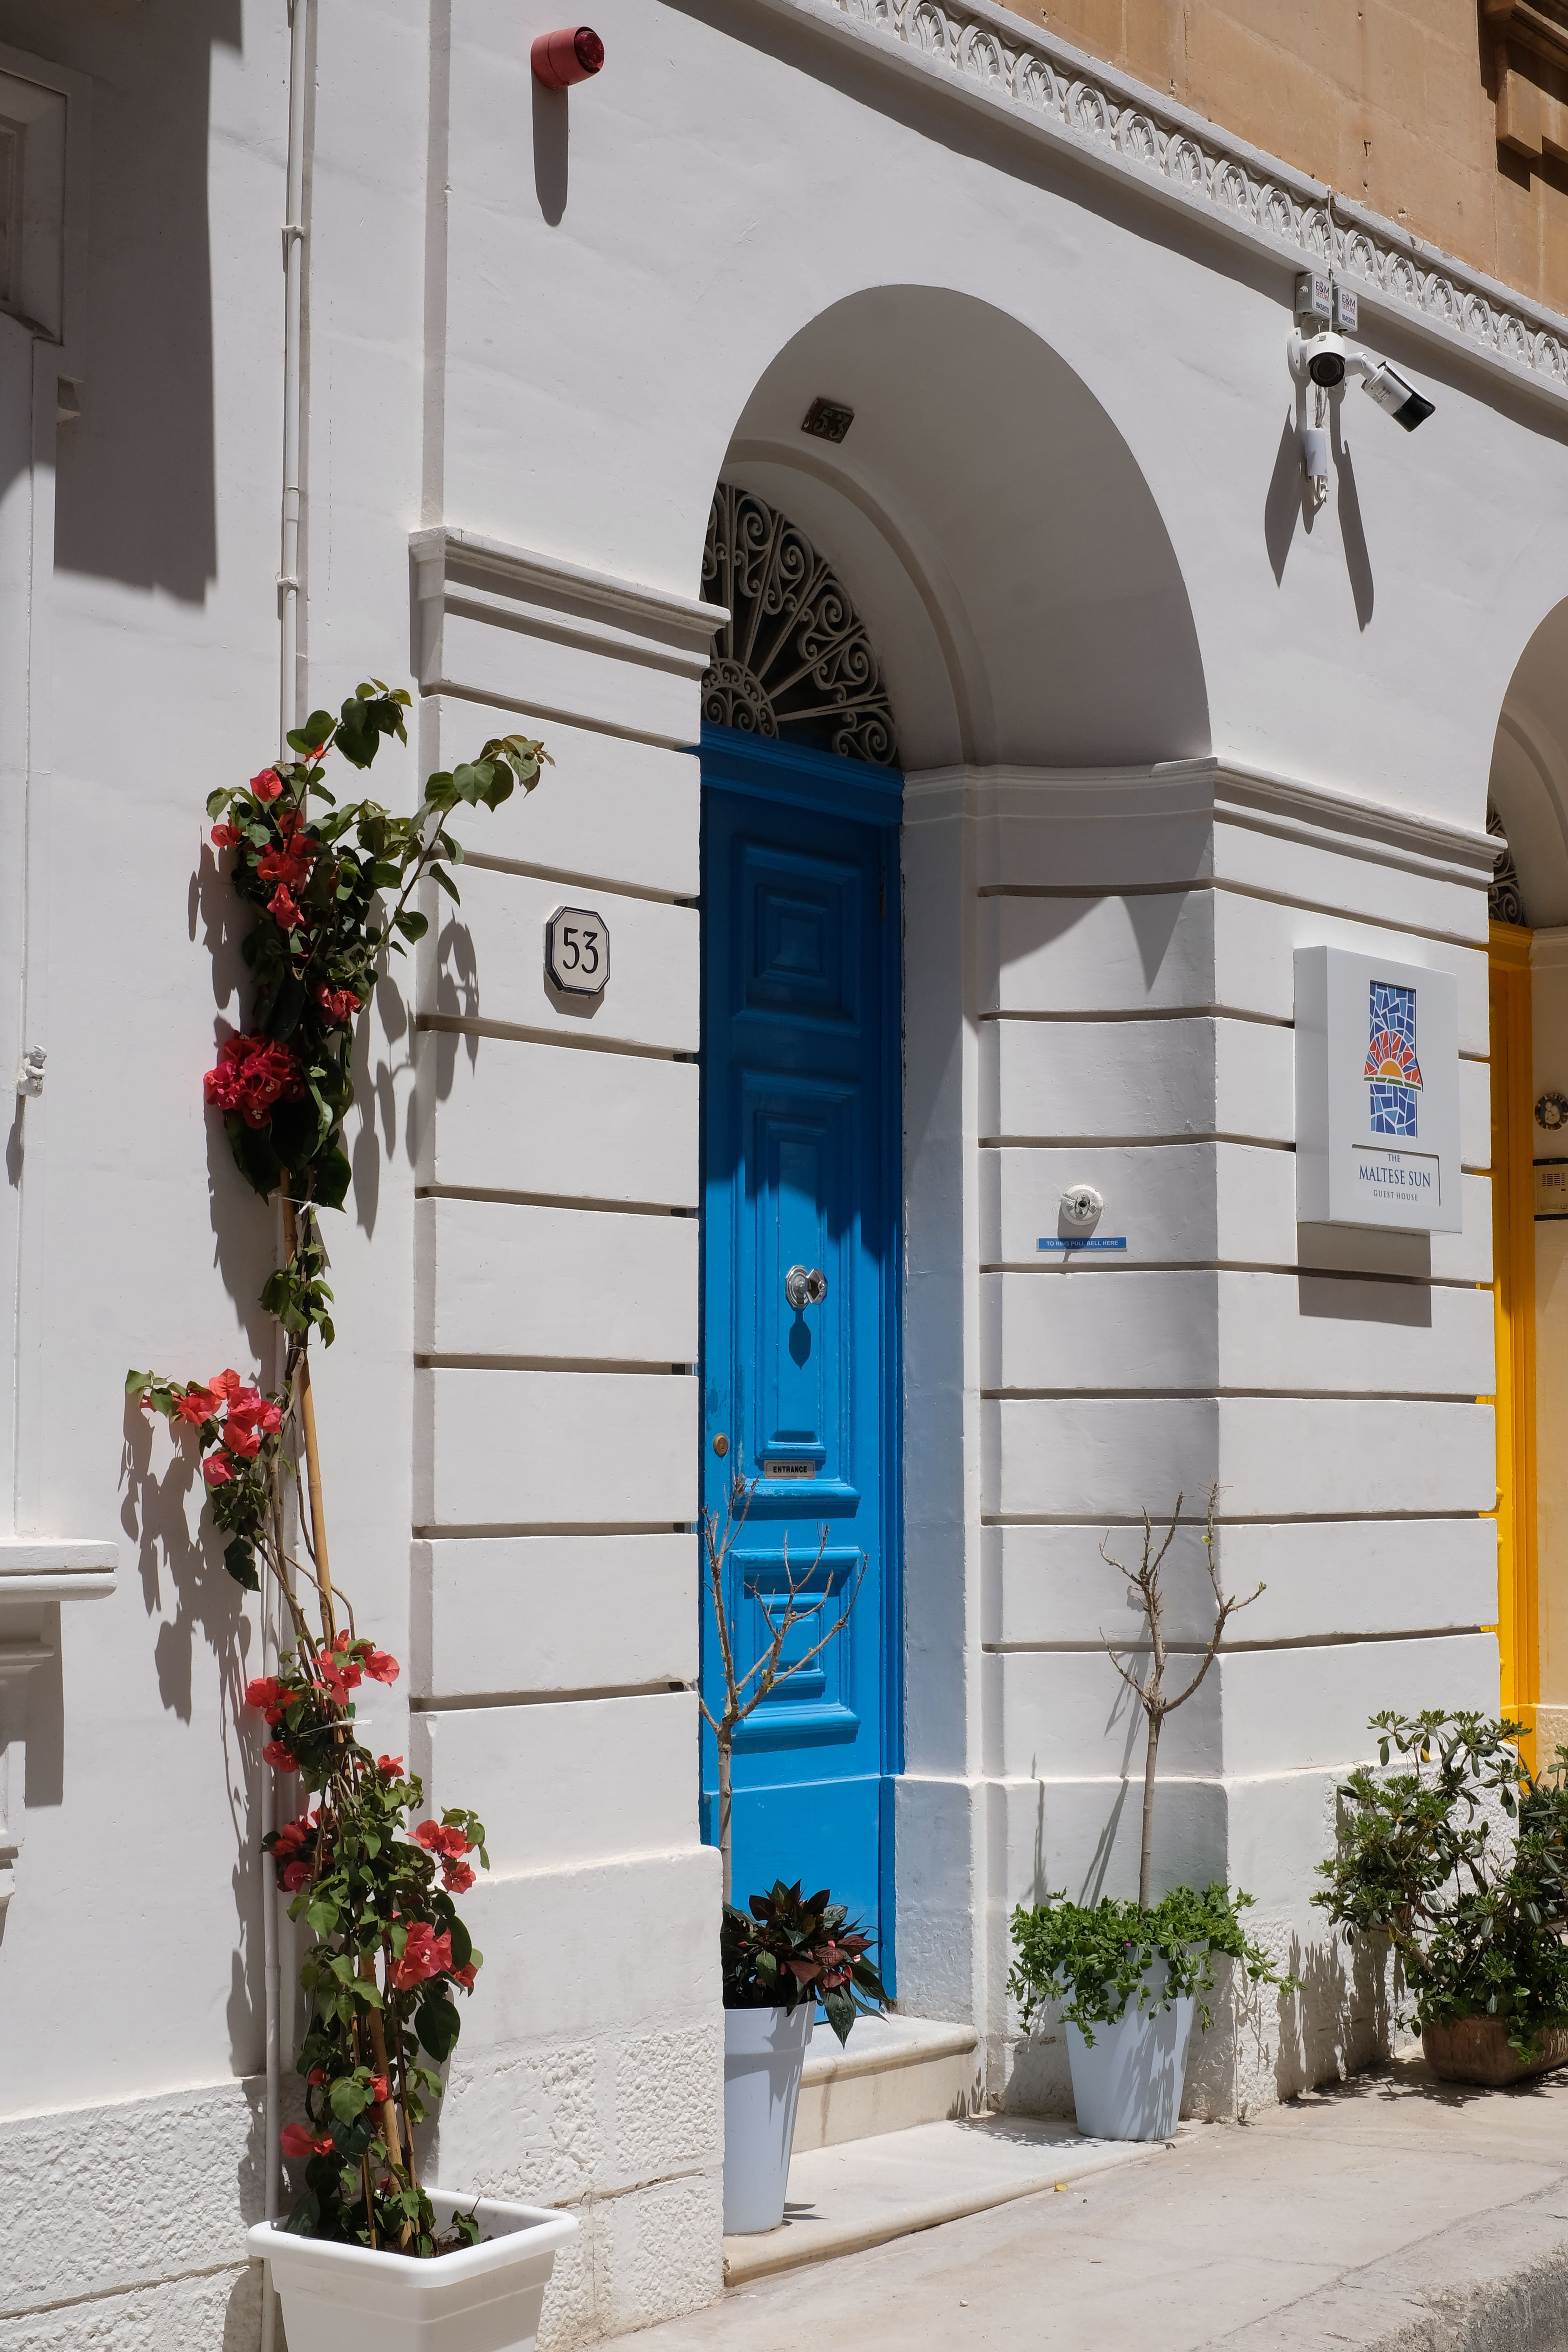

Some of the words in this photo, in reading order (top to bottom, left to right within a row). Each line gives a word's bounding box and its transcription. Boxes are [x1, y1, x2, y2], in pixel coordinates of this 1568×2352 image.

[1316, 281, 1329, 296] E&M
[1316, 290, 1329, 302] SECURE
[1342, 294, 1355, 309] E&M
[1342, 303, 1355, 314] SECURE
[813, 408, 850, 439] 53
[563, 927, 599, 974] 53
[1388, 1154, 1401, 1162] THE
[1359, 1165, 1405, 1185] MALTESE
[1409, 1171, 1430, 1187] SUN
[1373, 1190, 1394, 1198] GUEST
[1396, 1192, 1418, 1201] HOUSE
